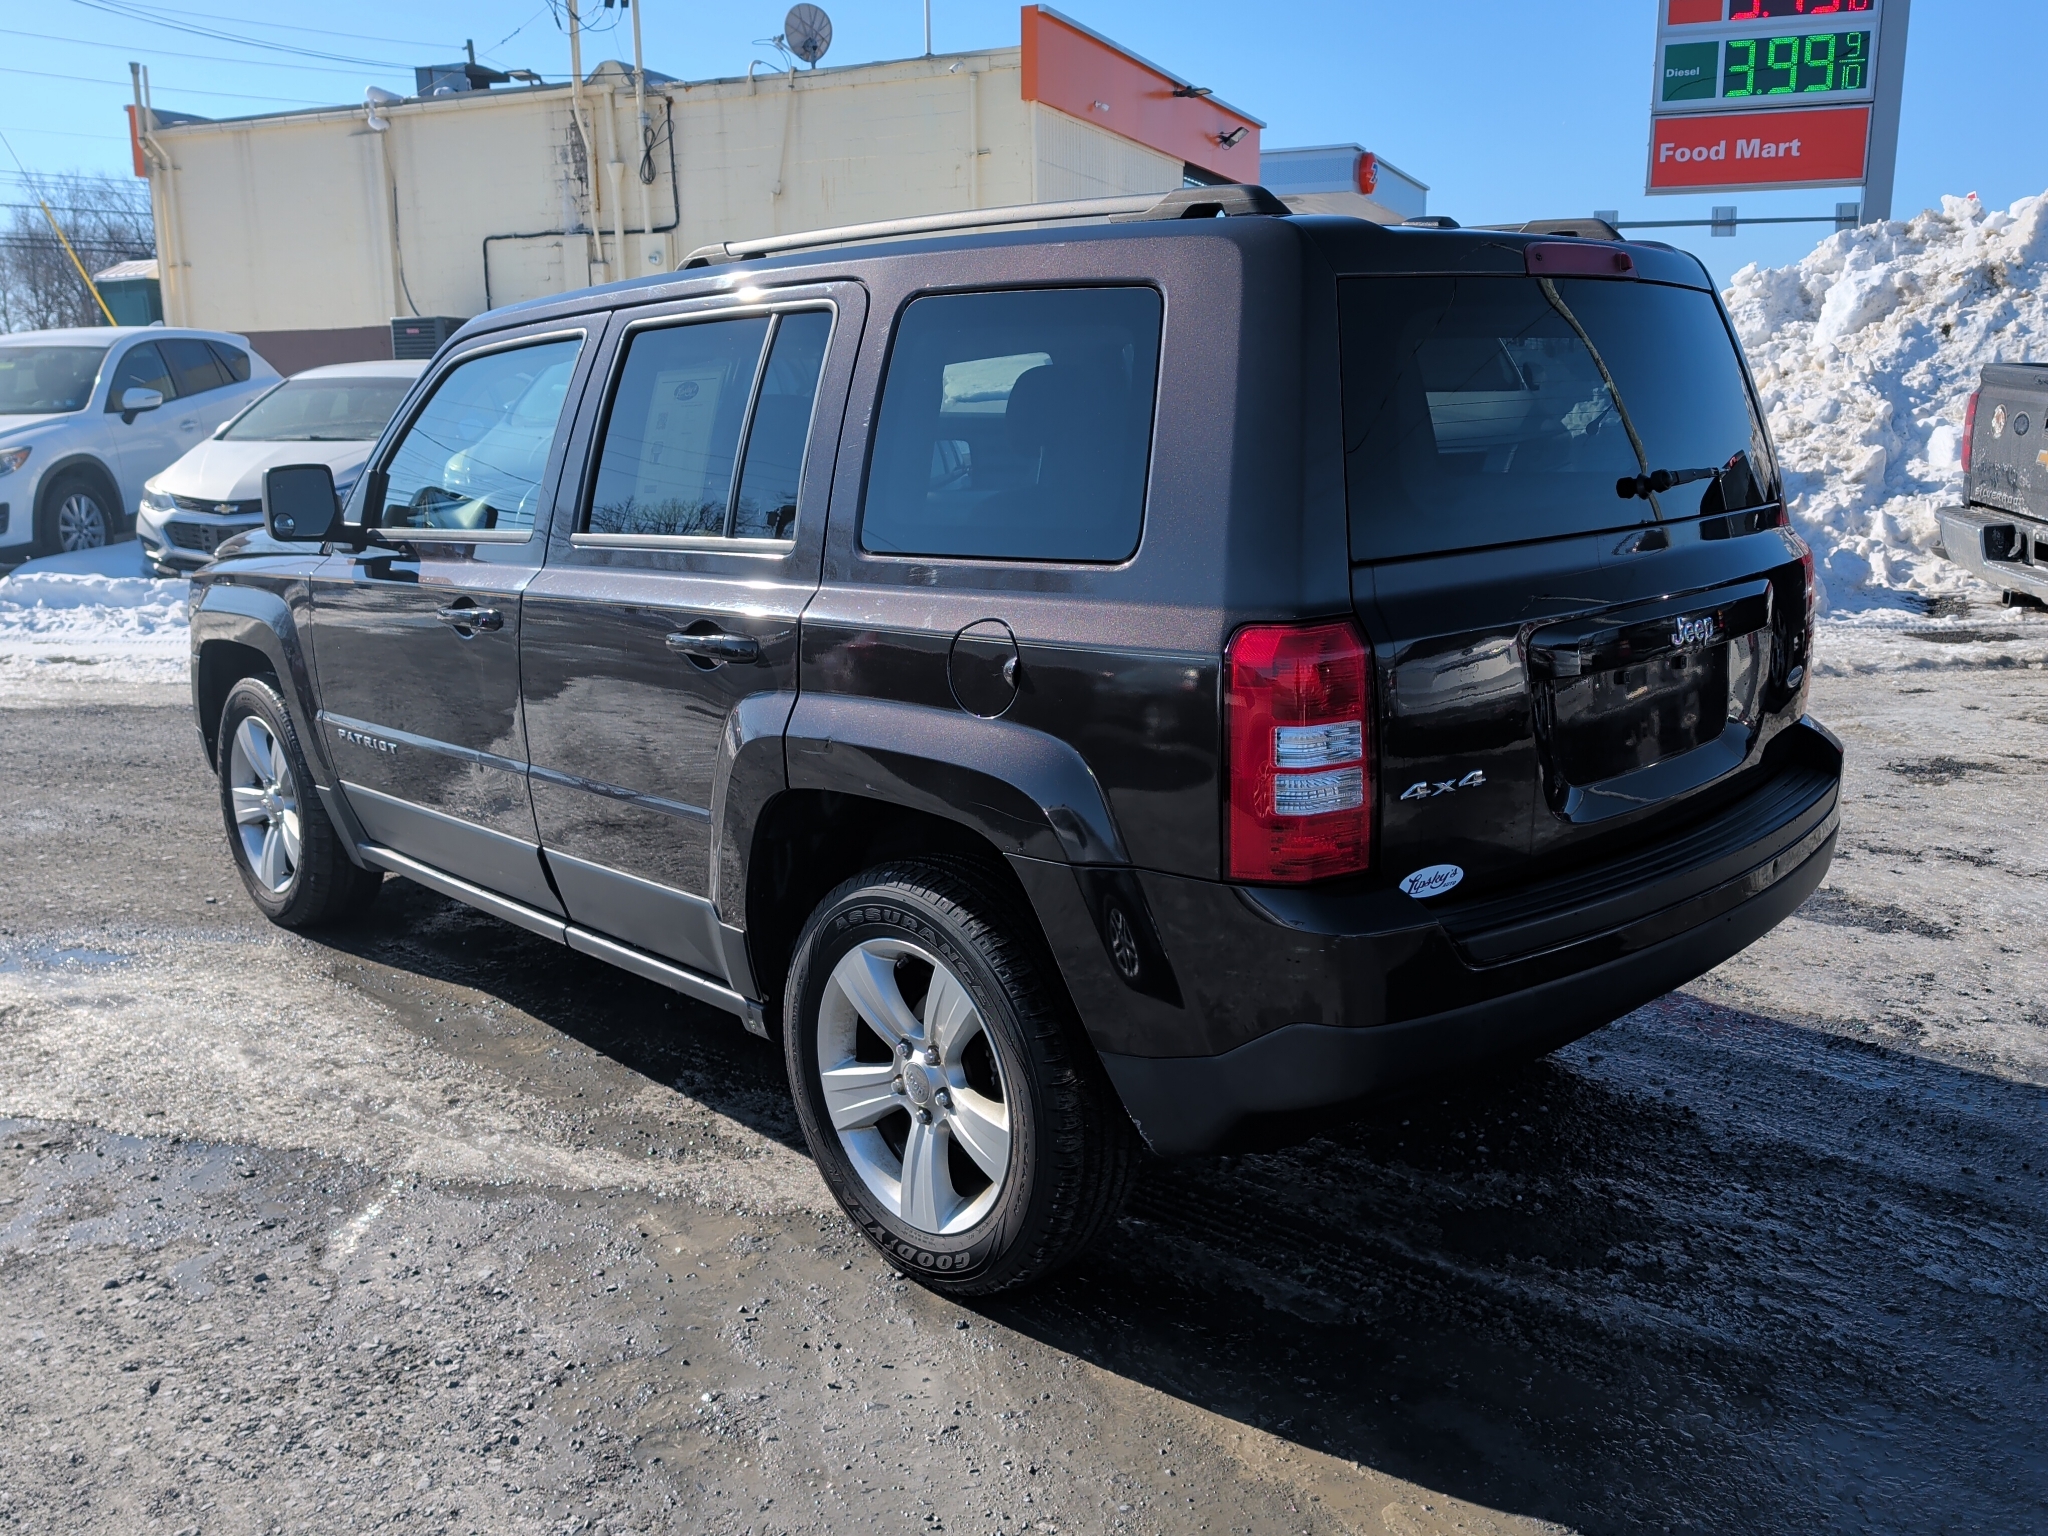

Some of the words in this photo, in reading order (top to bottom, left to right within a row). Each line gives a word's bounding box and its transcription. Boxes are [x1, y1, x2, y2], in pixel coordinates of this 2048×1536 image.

[1666, 66, 1700, 78] Diesel
[1725, 33, 1837, 97] 3.99
[1659, 141, 1727, 163] Food
[1735, 138, 1802, 160] Mart
[1671, 616, 1714, 648] Jeep
[337, 728, 398, 755] PATRIOT
[1399, 769, 1487, 801] 4x4
[835, 907, 993, 1009] ASSURANCE
[825, 1160, 971, 1270] GOODYEAR
